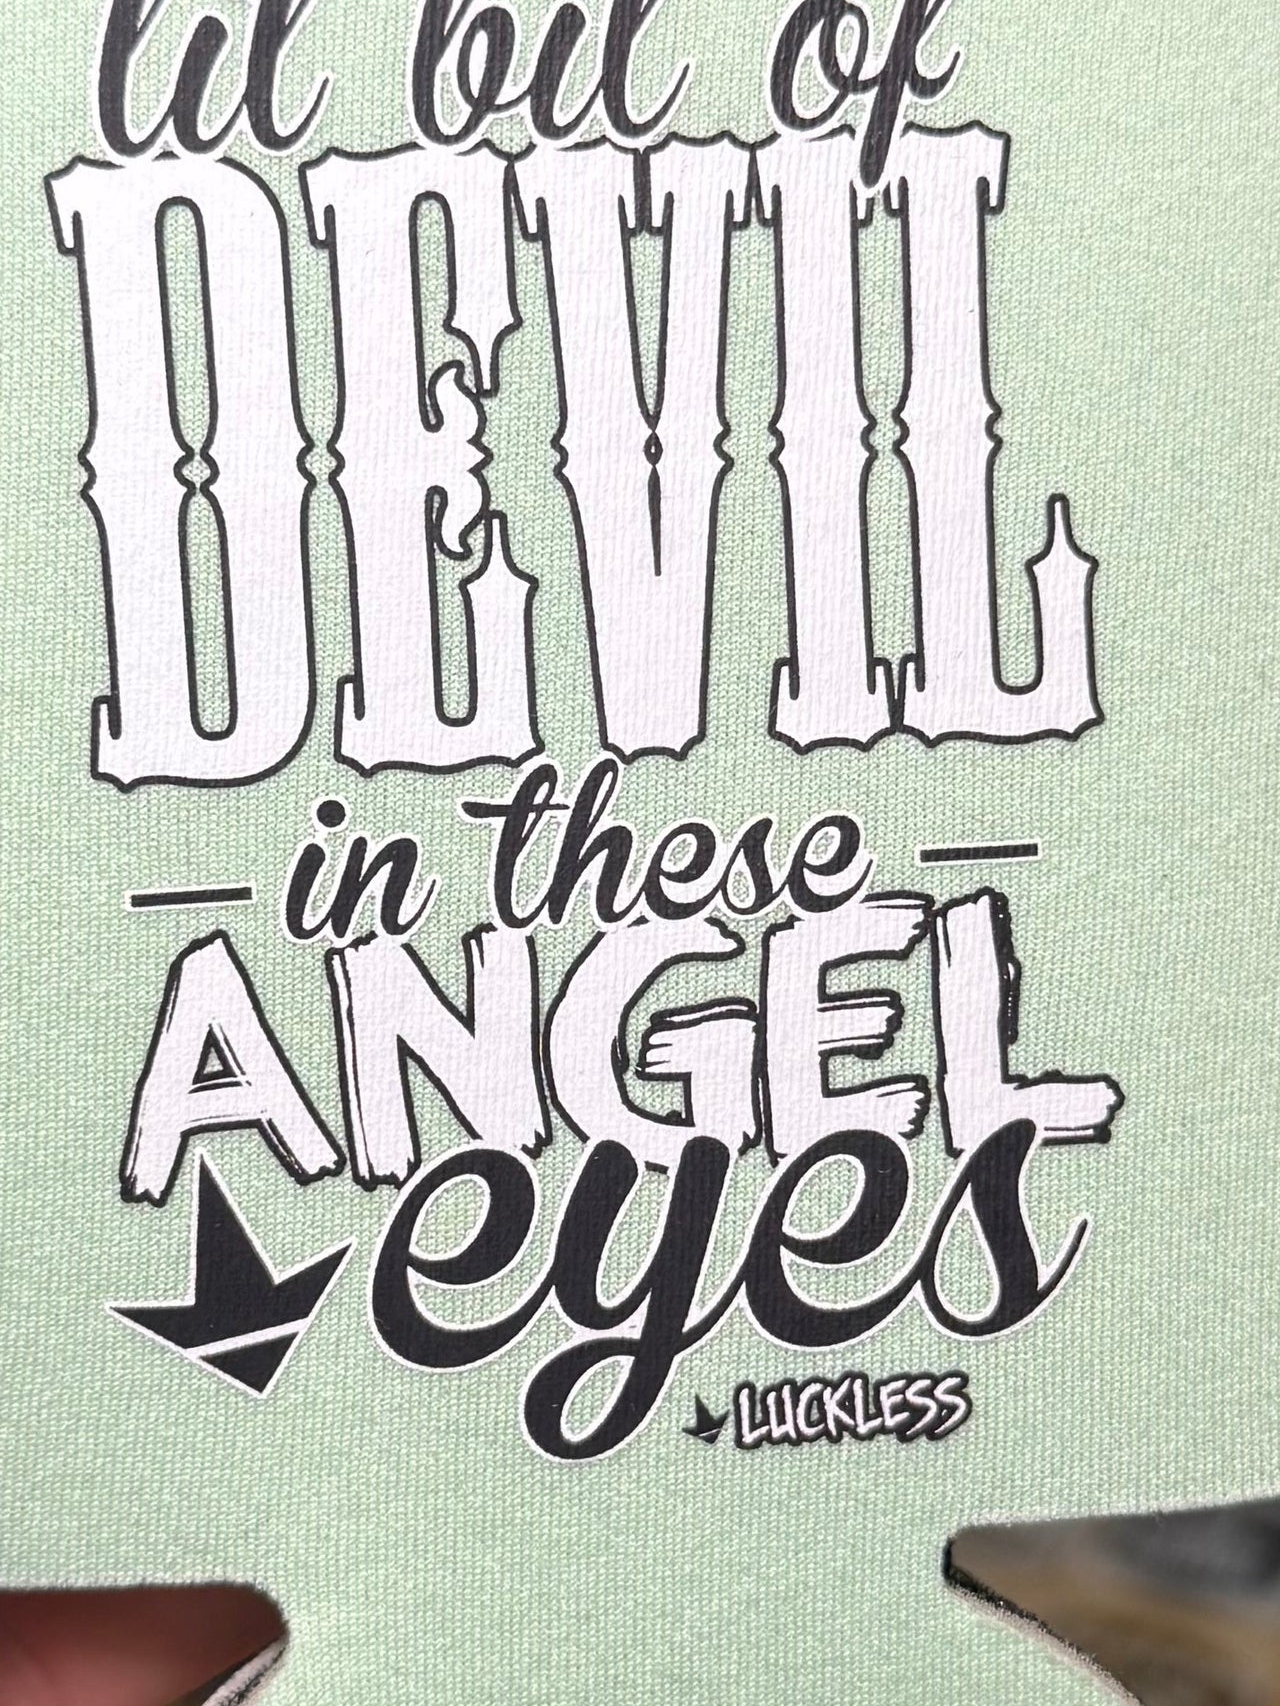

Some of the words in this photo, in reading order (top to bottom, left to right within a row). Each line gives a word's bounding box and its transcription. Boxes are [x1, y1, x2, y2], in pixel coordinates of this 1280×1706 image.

[44, 121, 1105, 791] DEVIL
[283, 797, 433, 939] in
[461, 759, 869, 928] these
[119, 887, 1124, 1204] ANGEL
[371, 1119, 1089, 1462] eyes
[733, 1369, 972, 1450] LUCKLESS
